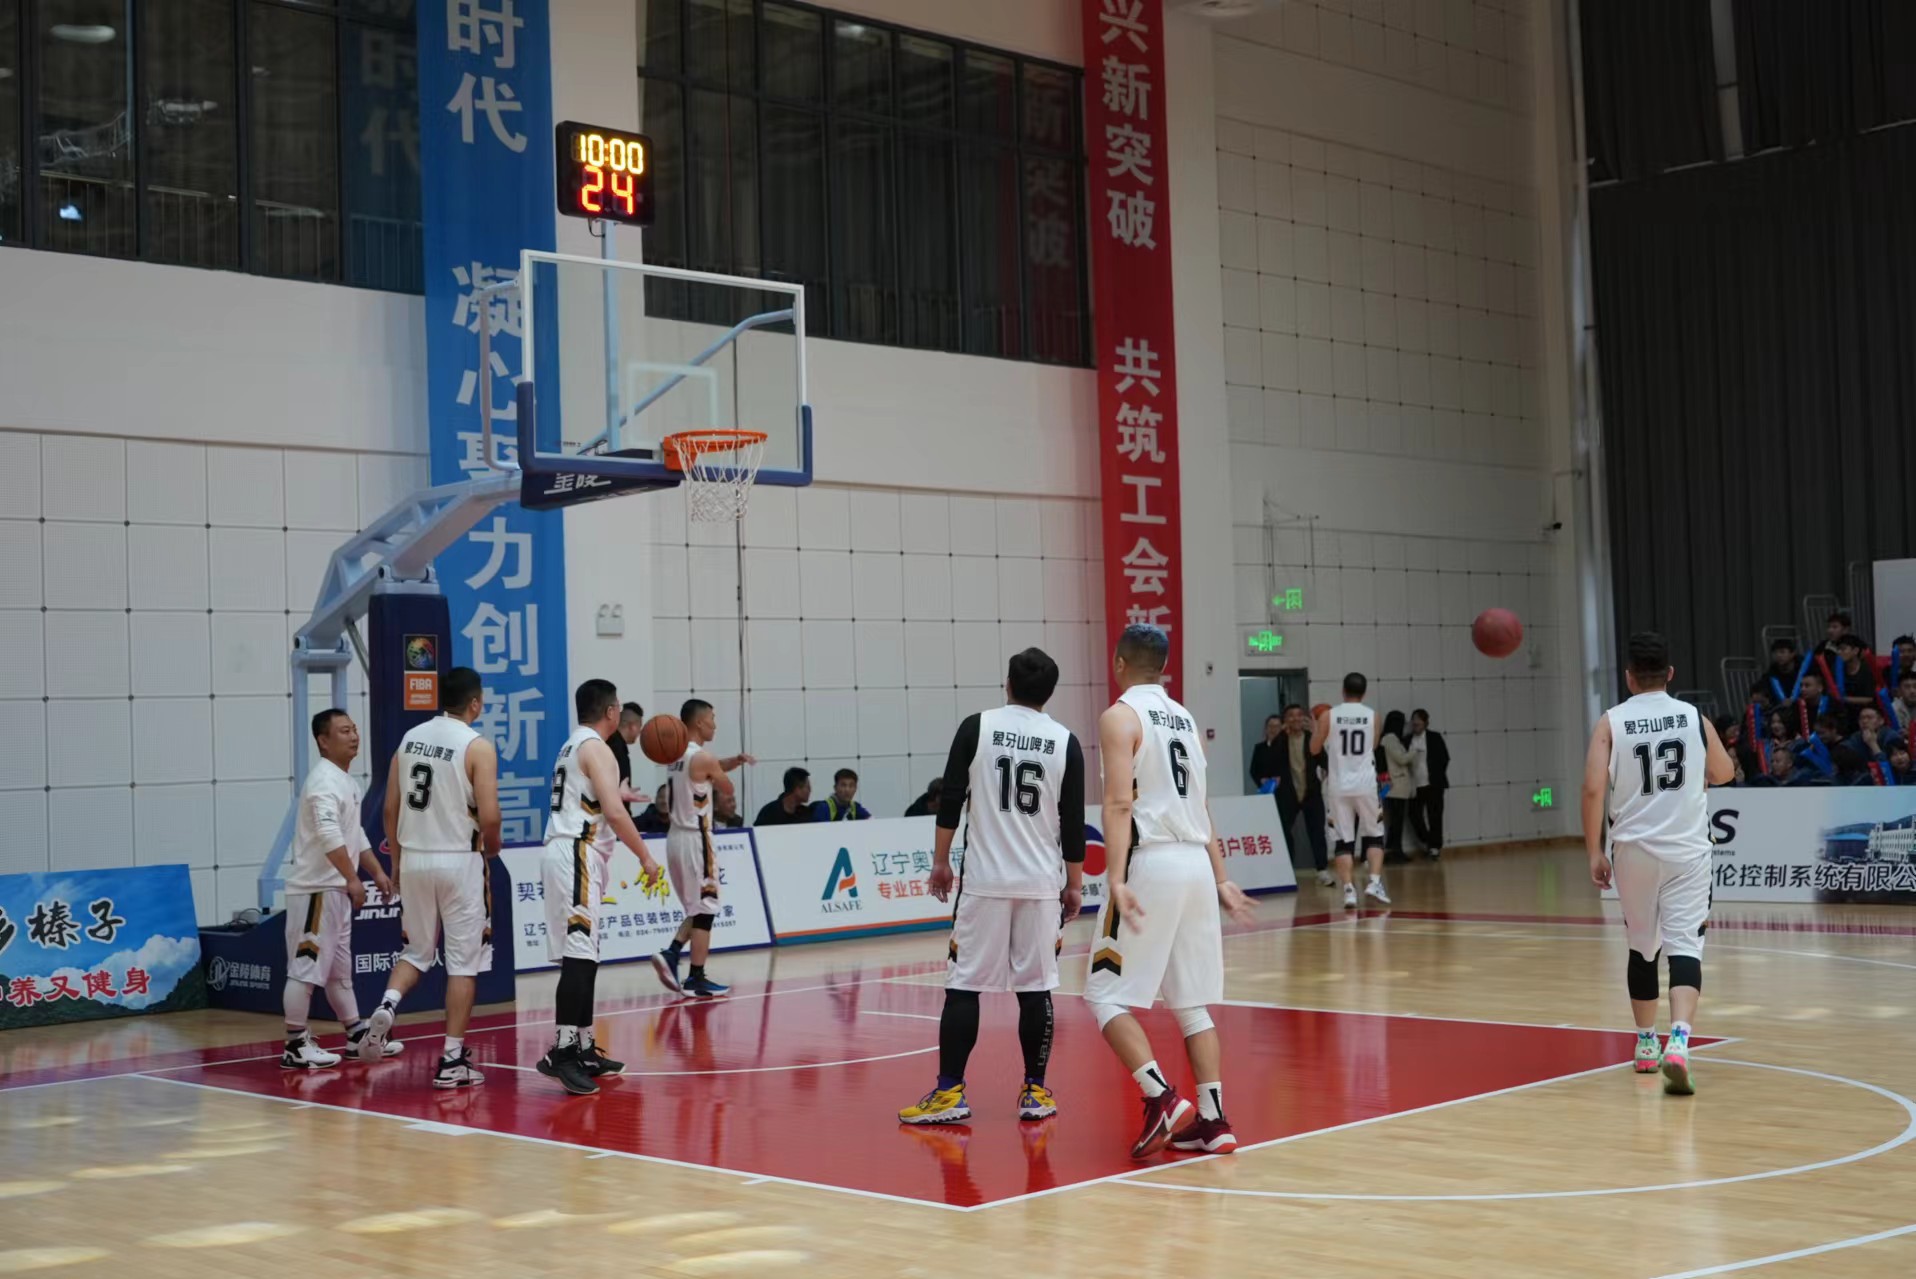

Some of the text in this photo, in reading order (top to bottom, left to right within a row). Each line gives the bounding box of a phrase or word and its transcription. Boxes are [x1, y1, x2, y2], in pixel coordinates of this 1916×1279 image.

[446, 0, 527, 153] 时代
[1100, 0, 1156, 250] 兴新突破
[580, 134, 643, 174] 10:00
[581, 165, 633, 215] 24
[410, 678, 432, 691] FIBA
[993, 731, 1055, 755] 象牙山啤酒
[1339, 729, 1365, 756] 10
[1624, 714, 1688, 734] 象牙山啤酒
[406, 762, 434, 812] 3
[995, 755, 1045, 817] 16
[1168, 738, 1189, 798] 6
[1633, 738, 1686, 796] 13
[821, 901, 862, 913] ALSAFE
[0, 967, 150, 1005] 养又健身
